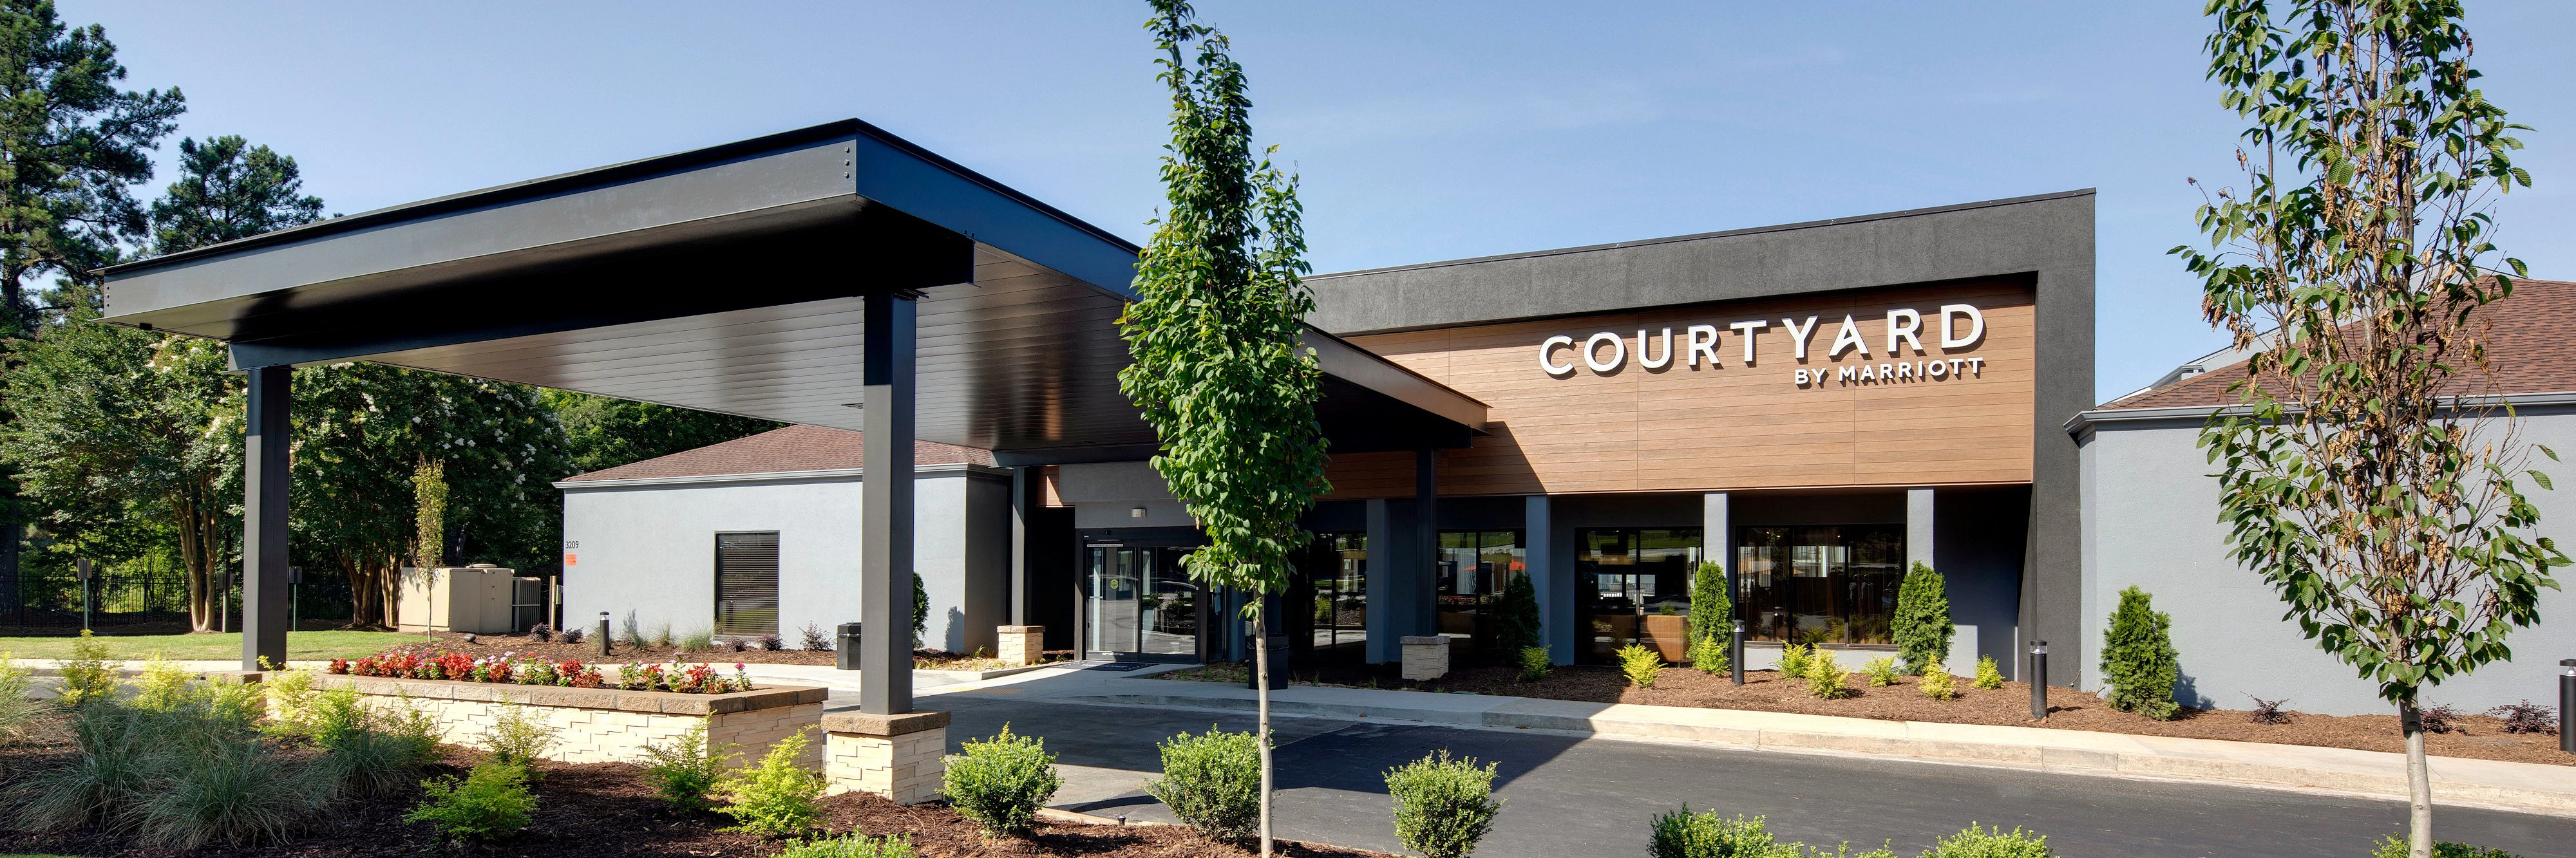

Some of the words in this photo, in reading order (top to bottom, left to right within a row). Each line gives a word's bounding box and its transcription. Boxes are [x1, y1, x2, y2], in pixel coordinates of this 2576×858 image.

[1538, 304, 1985, 376] COURTYARD
[1794, 368, 1827, 385] BY
[1838, 357, 1984, 382] MARRIOTT
[565, 541, 579, 549] 3209
